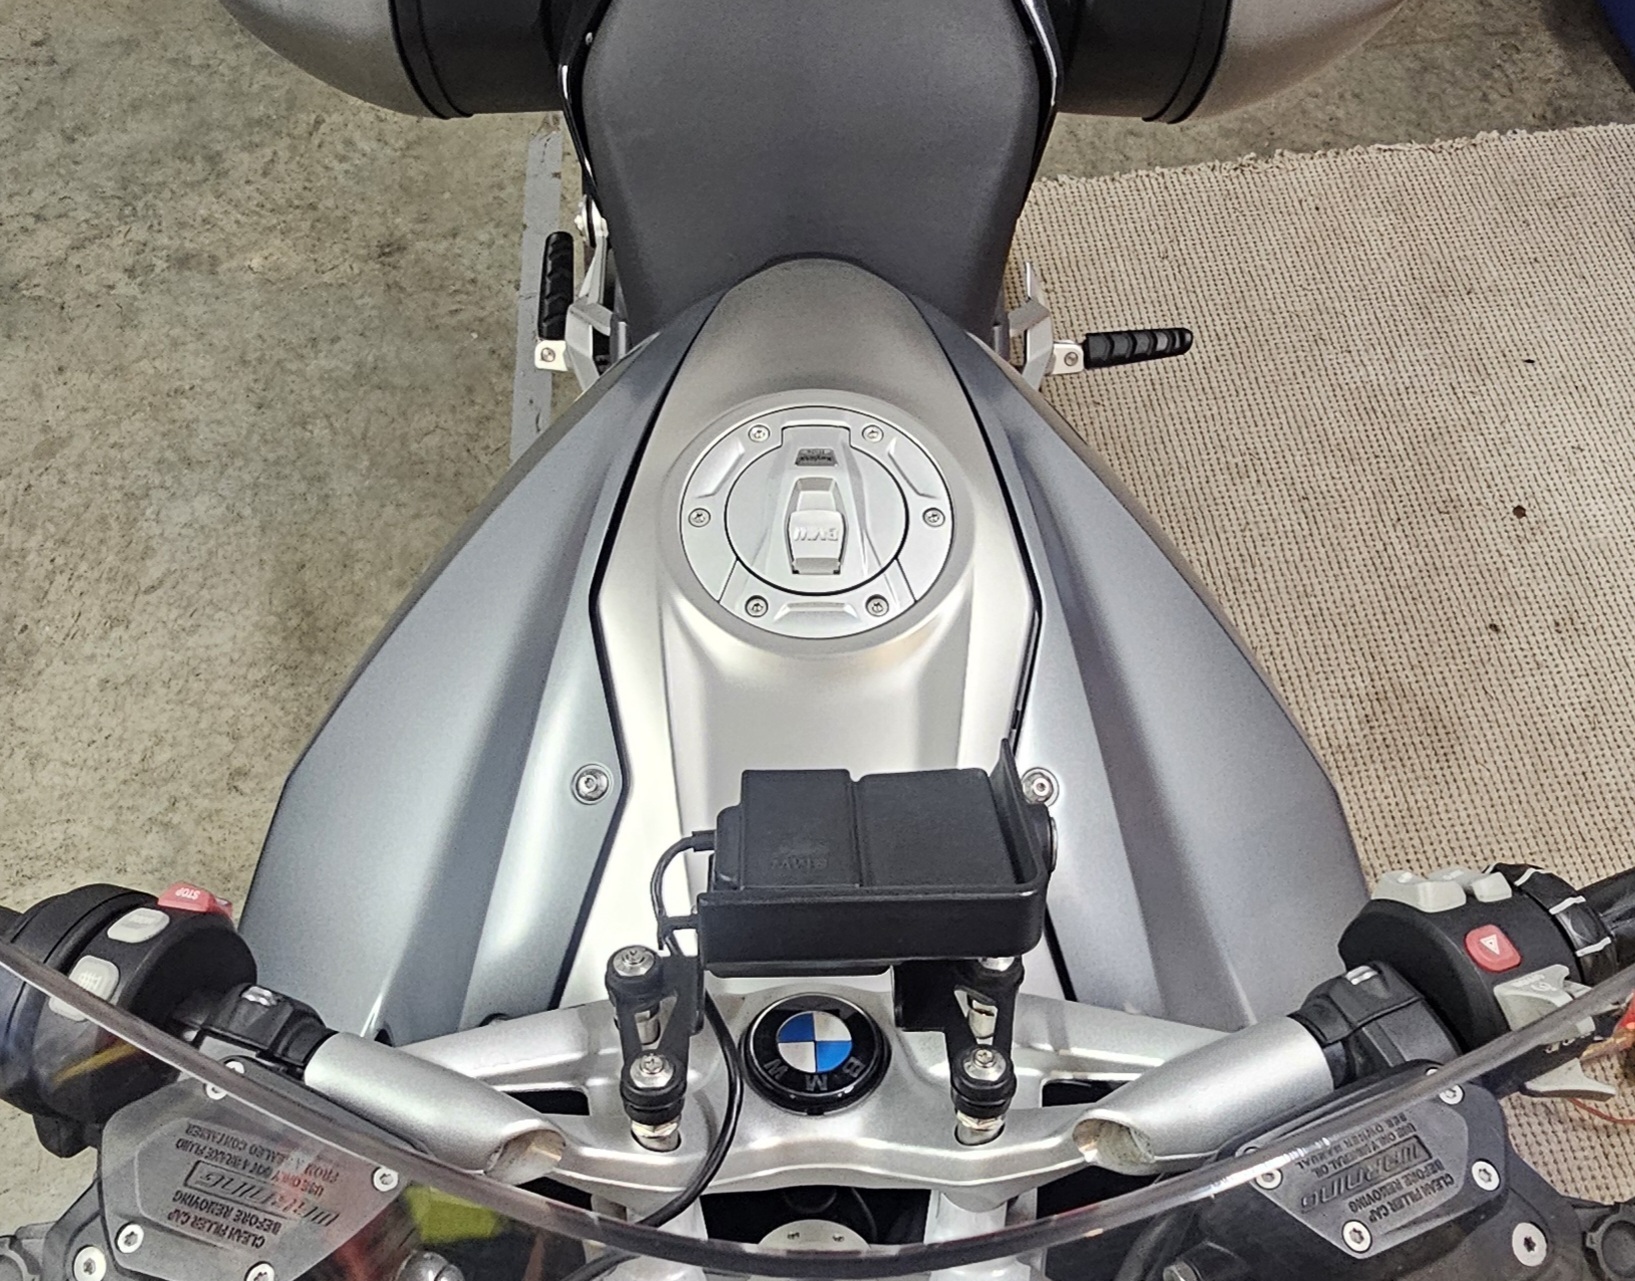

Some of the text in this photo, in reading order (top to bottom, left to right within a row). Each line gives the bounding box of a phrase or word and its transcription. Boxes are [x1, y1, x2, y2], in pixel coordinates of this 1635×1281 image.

[792, 526, 839, 542] BMW
[175, 887, 200, 899] STOP
[761, 1058, 862, 1091] BMW
[175, 1138, 207, 1157] FLUID
[185, 1124, 247, 1151] CONTAINER
[1369, 1135, 1396, 1152] ONLY
[206, 1146, 242, 1169] BRAKE
[1295, 1144, 1342, 1169] MANUAL
[304, 1164, 339, 1183] FROM
[1301, 1145, 1418, 1213] WARNING
[1311, 1165, 1332, 1178] OIL
[301, 1179, 324, 1197] USE
[1348, 1159, 1444, 1213] BEFORE REMOVING
[1368, 1174, 1455, 1223] CLEAN FILLER CAP
[172, 1190, 282, 1235] BEFORE REMOVING
[194, 1174, 340, 1226] WARNING
[168, 1209, 266, 1249] CLEAN FILLER CAP
